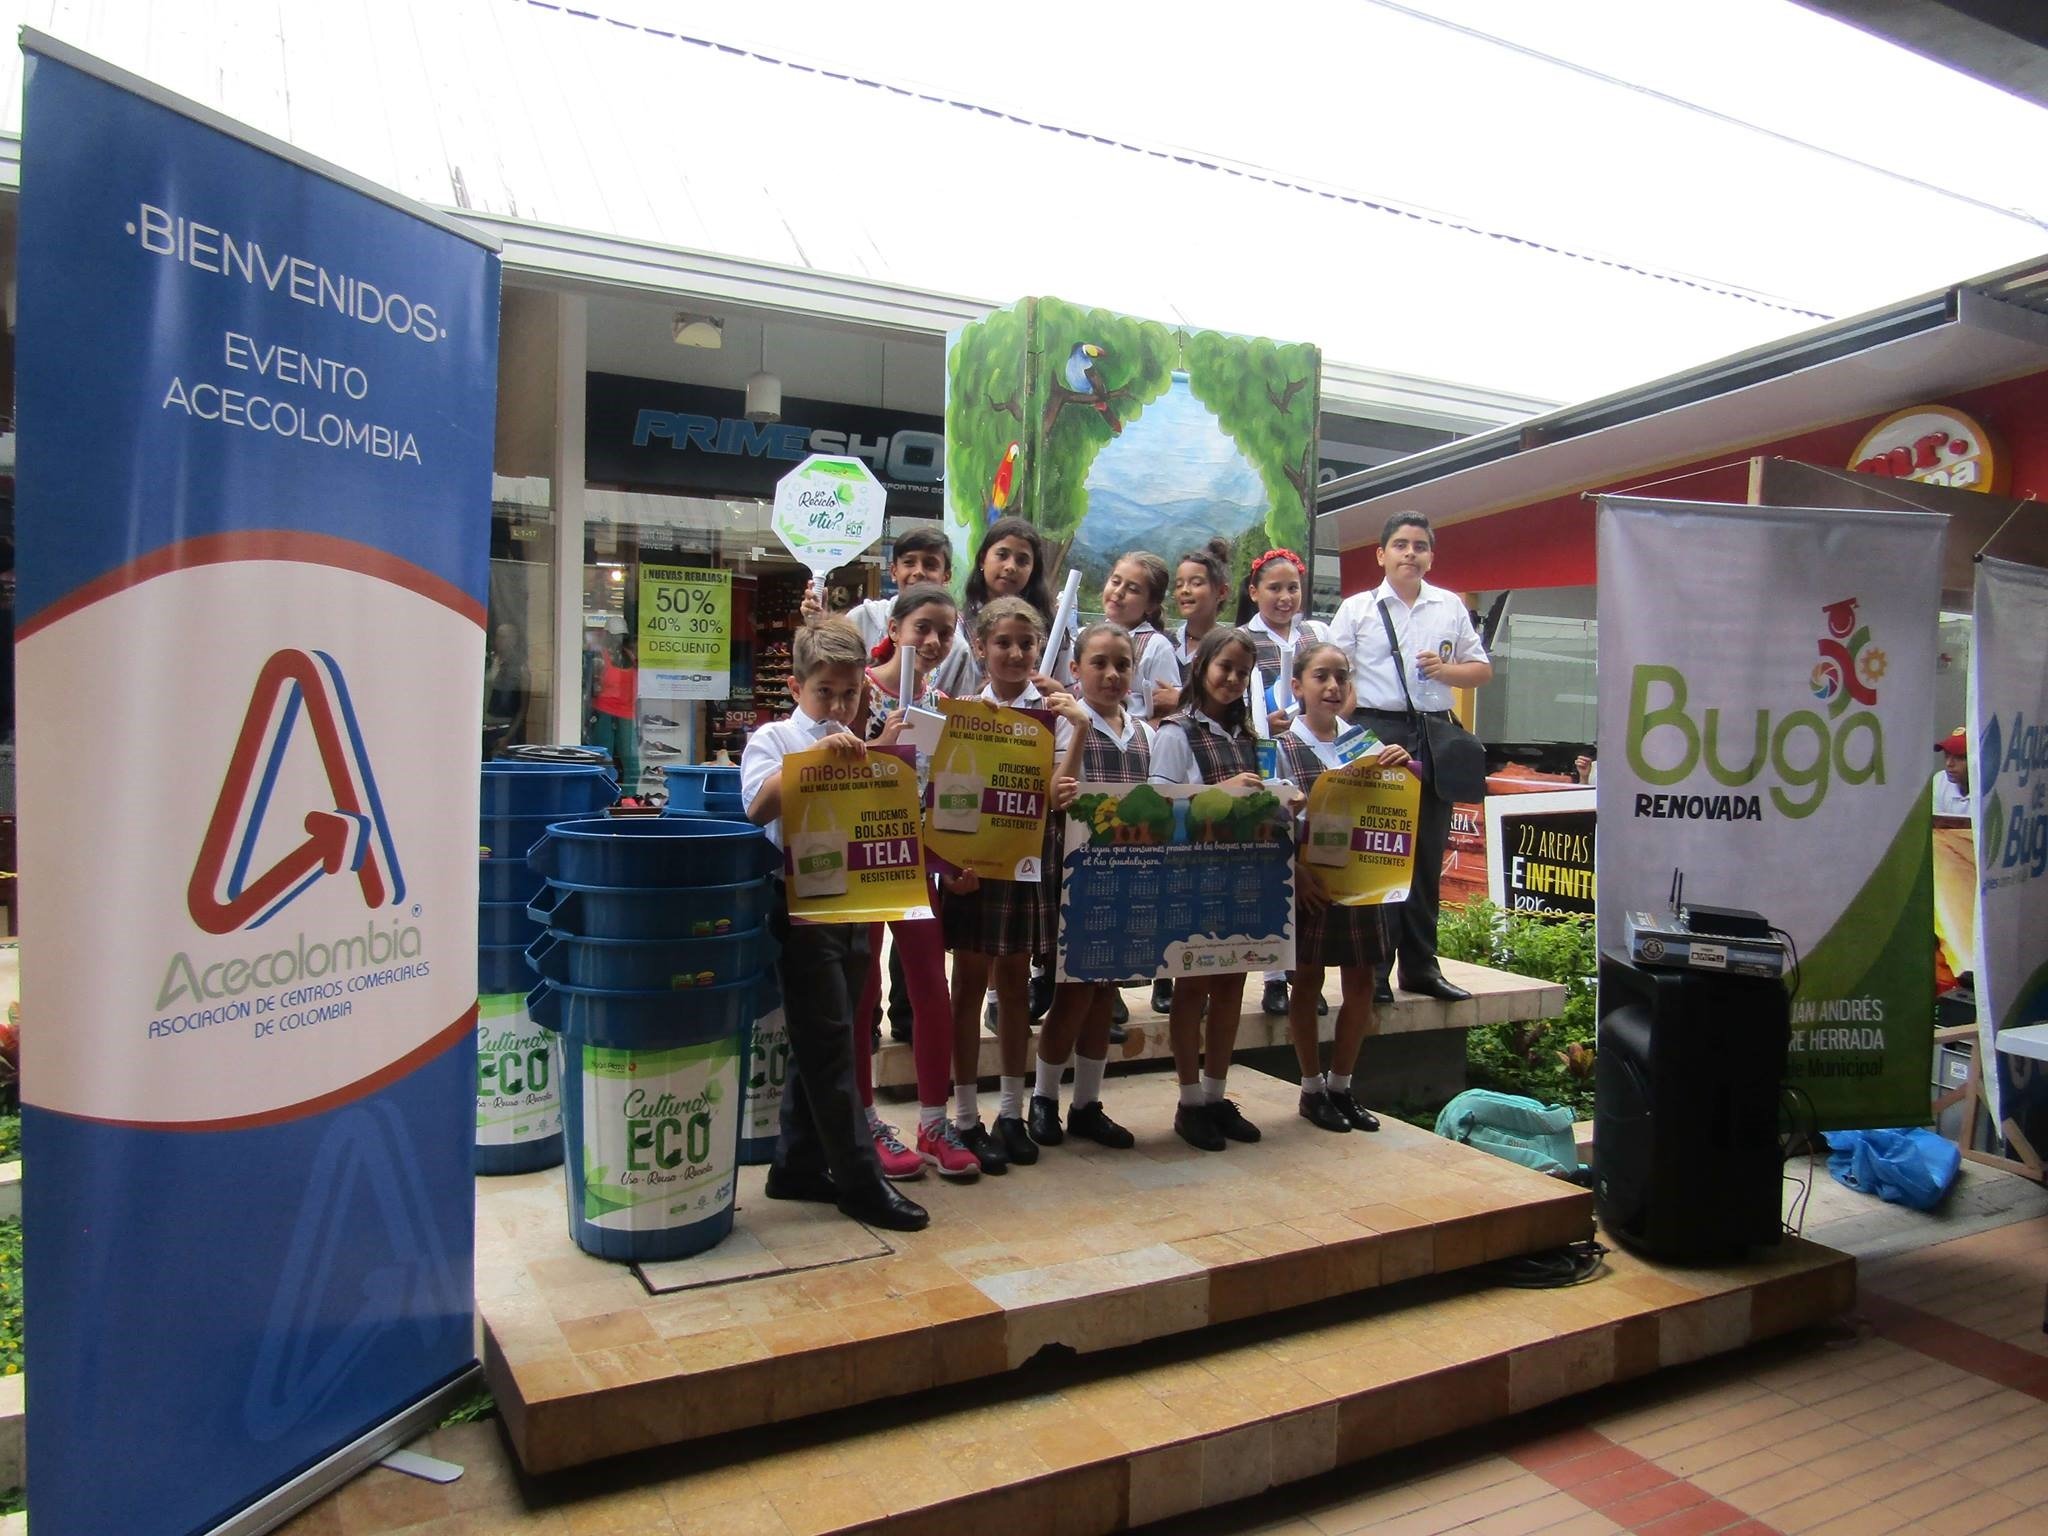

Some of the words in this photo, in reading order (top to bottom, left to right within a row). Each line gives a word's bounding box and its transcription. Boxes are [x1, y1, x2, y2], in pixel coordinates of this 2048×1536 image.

[225, 332, 368, 400] EVENTO
[162, 377, 422, 465] ACECOLOMBIA
[799, 490, 836, 508] Reciclo
[845, 523, 863, 536] ECO
[656, 588, 715, 614] 50%
[647, 617, 680, 631] 40%
[689, 618, 723, 633] 30%
[649, 641, 720, 654] DESCUENTO
[1624, 664, 1885, 819] Buga
[998, 763, 1040, 776] UTILICEMOS
[800, 784, 815, 793] VALE
[839, 782, 851, 791] QUE
[991, 774, 1030, 790] BOLSAS
[1033, 780, 1045, 791] DE
[996, 791, 1037, 816] TELA
[1366, 806, 1408, 817] UTILICEMOS
[1634, 793, 1762, 821] RENOVADA
[861, 809, 908, 822] UTILICEMOS
[991, 818, 1038, 831] RESISTENTES
[1360, 816, 1397, 829] BOLSAS
[1400, 820, 1412, 831] DE
[1451, 813, 1468, 831] EPA
[855, 823, 899, 839] BOLSAS
[903, 822, 915, 836] DE
[863, 840, 911, 866] TELA
[1364, 831, 1404, 853] TELA
[1518, 824, 1534, 856] 22
[1538, 831, 1589, 863] AREPAS
[812, 855, 830, 869] Bio
[1358, 854, 1405, 867] RESISTENTES
[860, 870, 916, 883] RESISTENTES
[1511, 856, 1525, 889] E
[1514, 893, 1545, 912] por
[155, 919, 422, 1012] Acecolombia
[148, 1000, 251, 1039] ASOCIACIÓN
[255, 996, 275, 1015] DE
[280, 981, 343, 1009] CENTROS
[347, 961, 430, 993] COMERCIALES
[1818, 994, 1884, 1021] ANDRÉS
[254, 1020, 274, 1038] DE
[279, 1001, 352, 1032] COLOMBIA
[1809, 1028, 1885, 1050] HERRADA
[477, 1048, 549, 1096] ECO
[624, 1088, 708, 1119] Cultura
[627, 1111, 712, 1171] ECO
